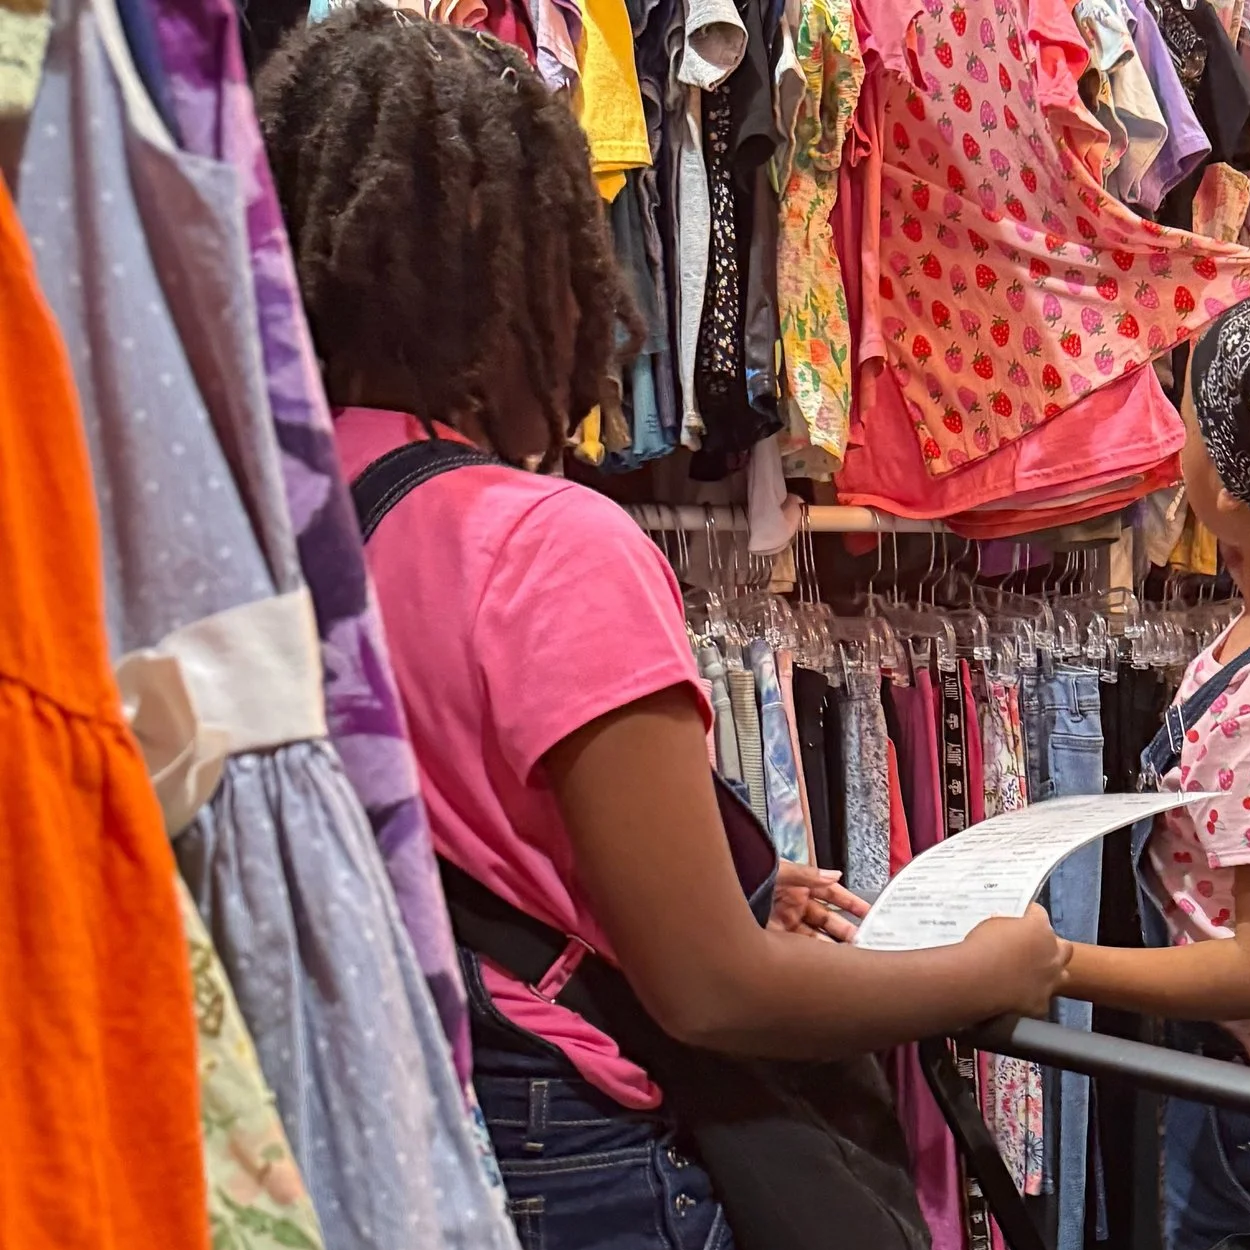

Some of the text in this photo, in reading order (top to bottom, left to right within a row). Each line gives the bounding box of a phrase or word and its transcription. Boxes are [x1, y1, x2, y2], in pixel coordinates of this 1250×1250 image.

[944, 675, 959, 700] JUICY
[946, 742, 962, 767] JUICY
[958, 1057, 974, 1079] JUICY
